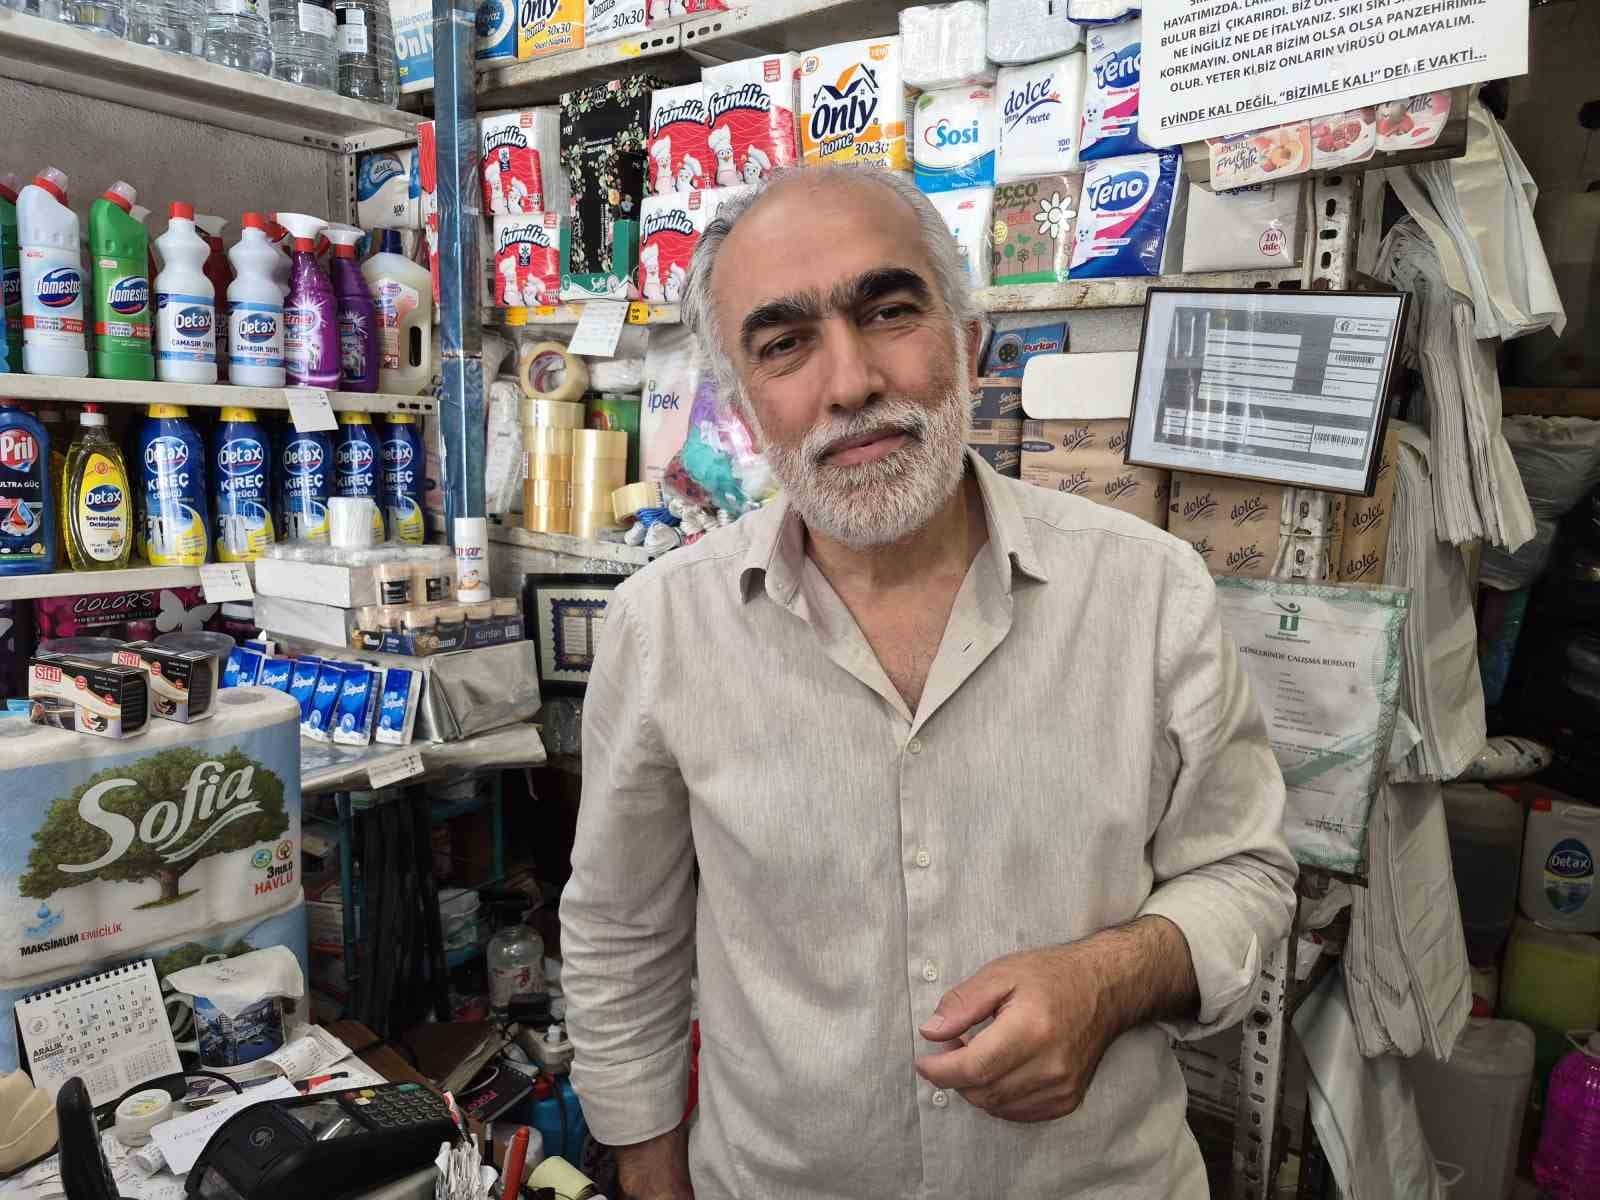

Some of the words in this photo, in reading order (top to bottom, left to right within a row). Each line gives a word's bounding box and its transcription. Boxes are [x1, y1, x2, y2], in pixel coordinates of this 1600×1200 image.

[612, 8, 645, 30] 30x30
[1160, 27, 1197, 48] BULUR
[1199, 22, 1221, 37] BİZİ
[1225, 6, 1289, 31] ÇIKARIRDI.
[1163, 1, 1242, 31] HAYATIMIZDA.
[1173, 47, 1188, 60] NE
[1190, 36, 1232, 55] İNGİLİZ
[1234, 32, 1250, 45] NE
[1252, 27, 1269, 41] DE
[1271, 10, 1336, 37] İTALYANIZ.
[1338, 2, 1363, 18] SIKI
[1160, 55, 1230, 79] KORKMAYIN.
[1232, 44, 1273, 62] ONLAR
[1275, 33, 1310, 51] BİZİM
[1312, 26, 1346, 42] OLSA
[1349, 15, 1383, 33] OLSA
[1169, 77, 1204, 93] OLUR.
[1205, 69, 1241, 85] YETER
[1257, 58, 1276, 74] BİZ
[1279, 47, 1335, 69] ONLARIN
[1337, 32, 1385, 52] VİRÜSÜ
[1388, 14, 1476, 41] OLMAYALIM.
[708, 84, 771, 128] familia
[1004, 78, 1052, 116] dolce
[654, 100, 705, 139] familia
[811, 96, 879, 139] Only
[1160, 107, 1206, 128] EVİNDE
[1208, 102, 1233, 118] KAL
[1235, 93, 1277, 112] DEĞİL,
[483, 126, 527, 160] familia
[935, 119, 979, 148] Sosi
[1087, 174, 1144, 211] Teno
[500, 223, 550, 254] familia
[642, 209, 694, 245] familia
[1262, 242, 1281, 252] ade
[107, 287, 150, 304] Domesto
[175, 312, 212, 329] Detax
[239, 319, 276, 335] Detax
[1023, 341, 1058, 353] Furkan
[648, 391, 680, 414] ipek
[0, 435, 34, 462] Pril
[1062, 426, 1089, 448] dolce
[1108, 429, 1128, 450] dol
[146, 444, 186, 464] Detax
[220, 447, 262, 465] Detax
[284, 447, 321, 465] Detax
[336, 447, 373, 465] Detax
[383, 448, 413, 461] etax
[147, 473, 190, 491] KİREÇ
[220, 474, 264, 492] KİREÇ
[385, 470, 414, 484] İREÇ
[1058, 469, 1086, 492] dolce
[1104, 474, 1133, 496] dolce
[84, 488, 121, 506] Detax
[1183, 493, 1211, 517] dolce
[1230, 495, 1261, 520] dolce
[1226, 542, 1257, 567] dolce
[73, 591, 154, 613] COLORS
[57, 761, 256, 873] Sofia
[267, 865, 275, 879] 3
[1551, 854, 1590, 869] Detax
[255, 871, 293, 896] HAVLU
[19, 933, 80, 957] MAKSİMUM
[80, 921, 123, 942] EMİCİLİK
[33, 1041, 63, 1057] ARALIK
